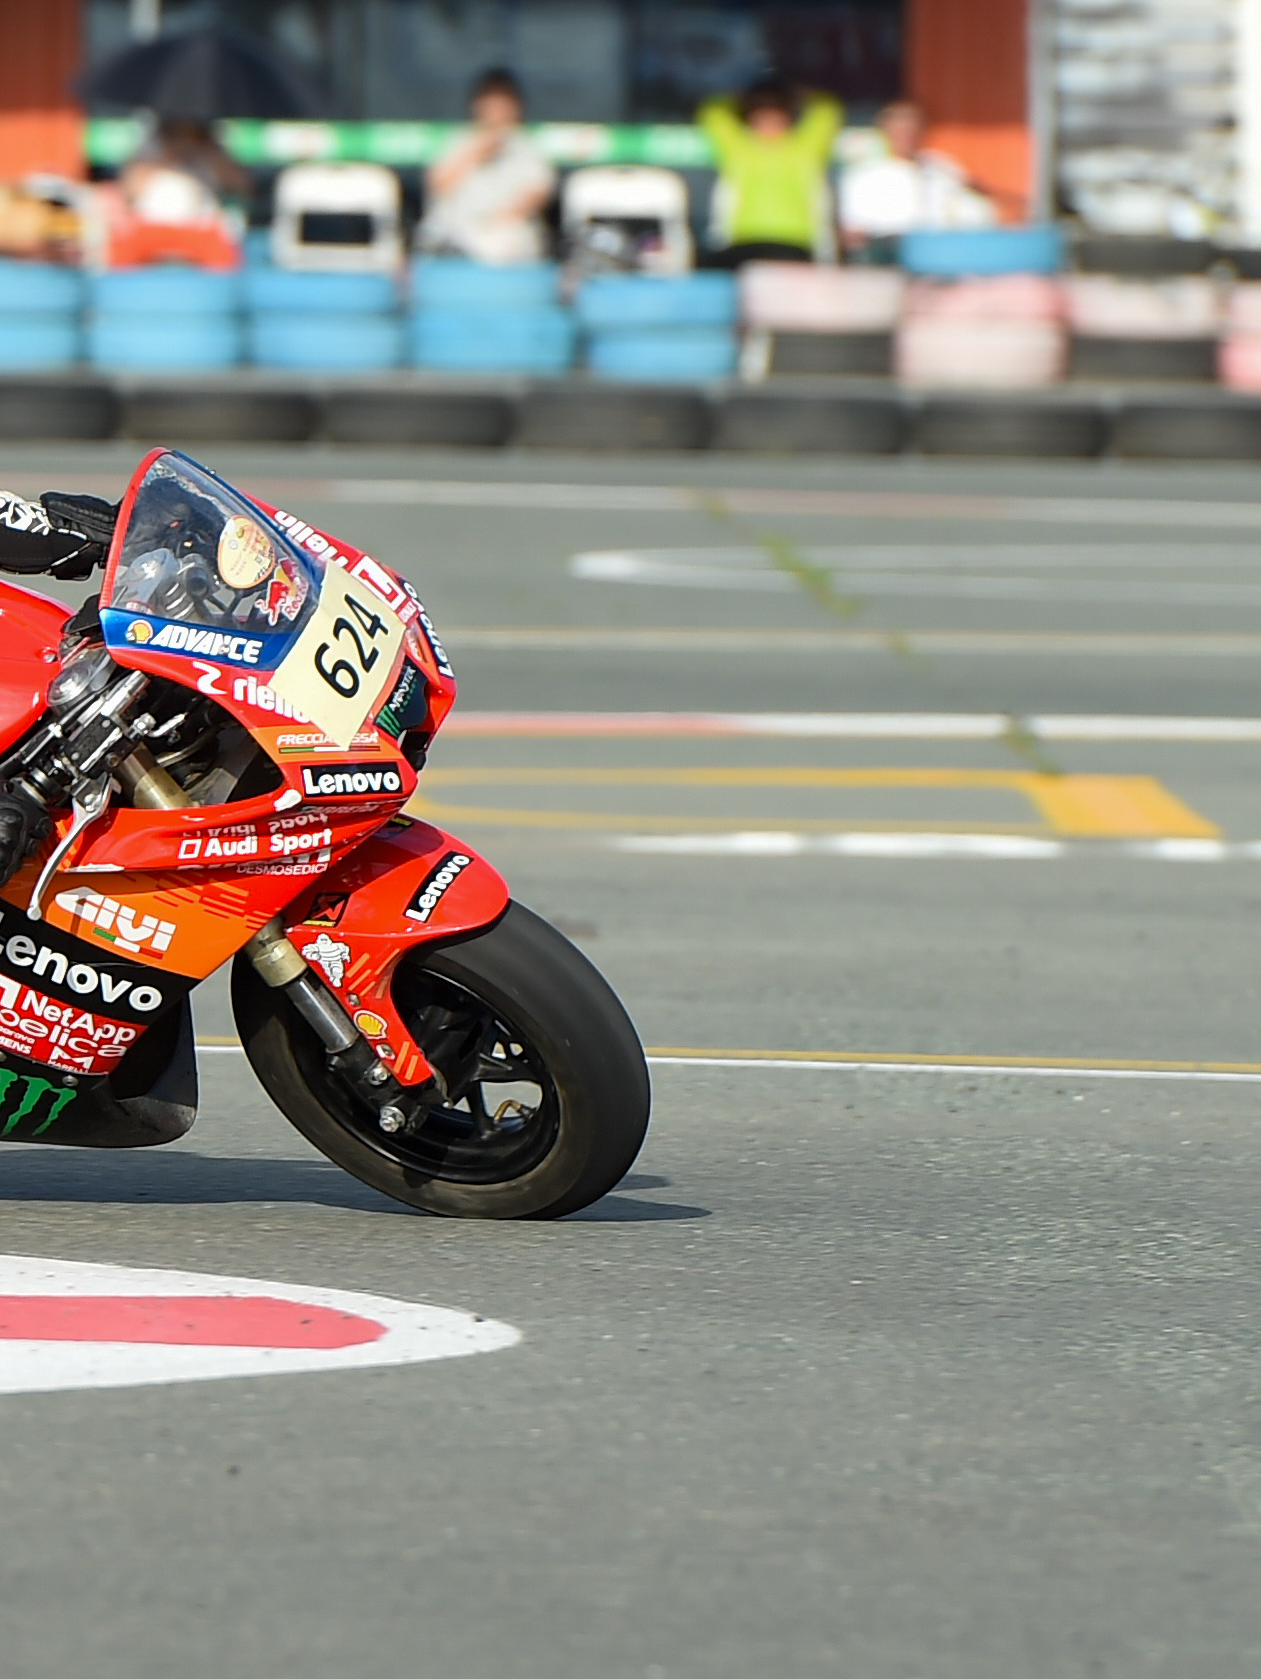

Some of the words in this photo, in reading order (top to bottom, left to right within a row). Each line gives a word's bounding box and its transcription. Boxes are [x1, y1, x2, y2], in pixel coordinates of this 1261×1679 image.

[149, 623, 263, 664] ADVANCE
[314, 593, 390, 699] 624
[403, 582, 455, 678] Lenovo
[277, 731, 379, 746] FRECCIASSA
[302, 768, 401, 795] Lenovo
[203, 835, 258, 858] Audi
[269, 828, 333, 855] Sport
[236, 862, 329, 876] DESMOSEDICI
[404, 854, 471, 923] Lenovo
[21, 989, 137, 1044] NetApp
